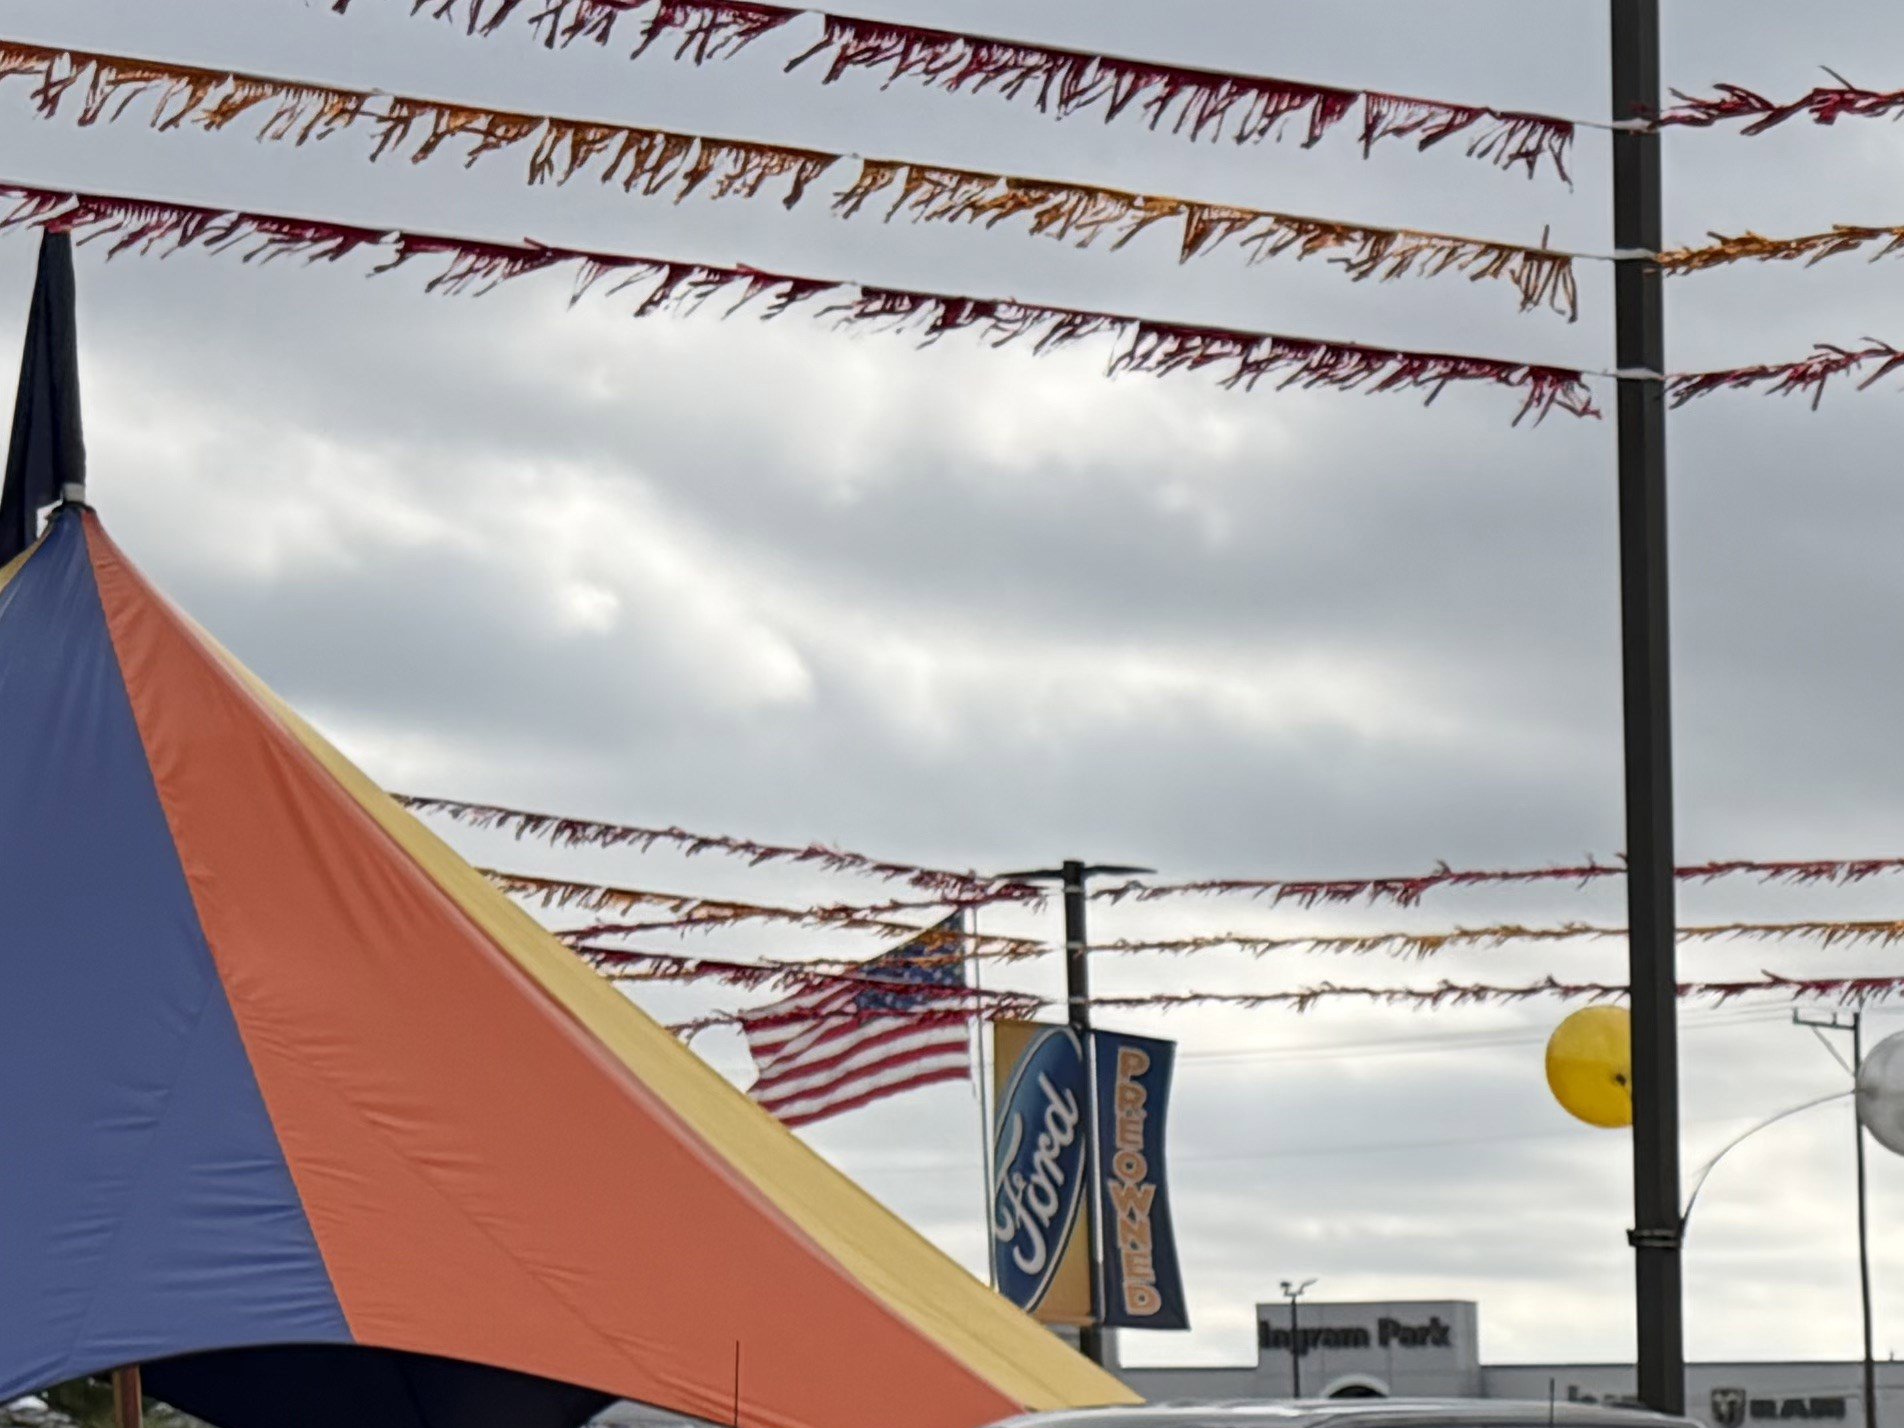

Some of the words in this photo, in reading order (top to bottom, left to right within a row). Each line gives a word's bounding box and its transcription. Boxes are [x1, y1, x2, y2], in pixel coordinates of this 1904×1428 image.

[993, 1073, 1080, 1276] Ford
[1107, 1046, 1162, 1316] PREOWNED
[1378, 1316, 1451, 1347] Park
